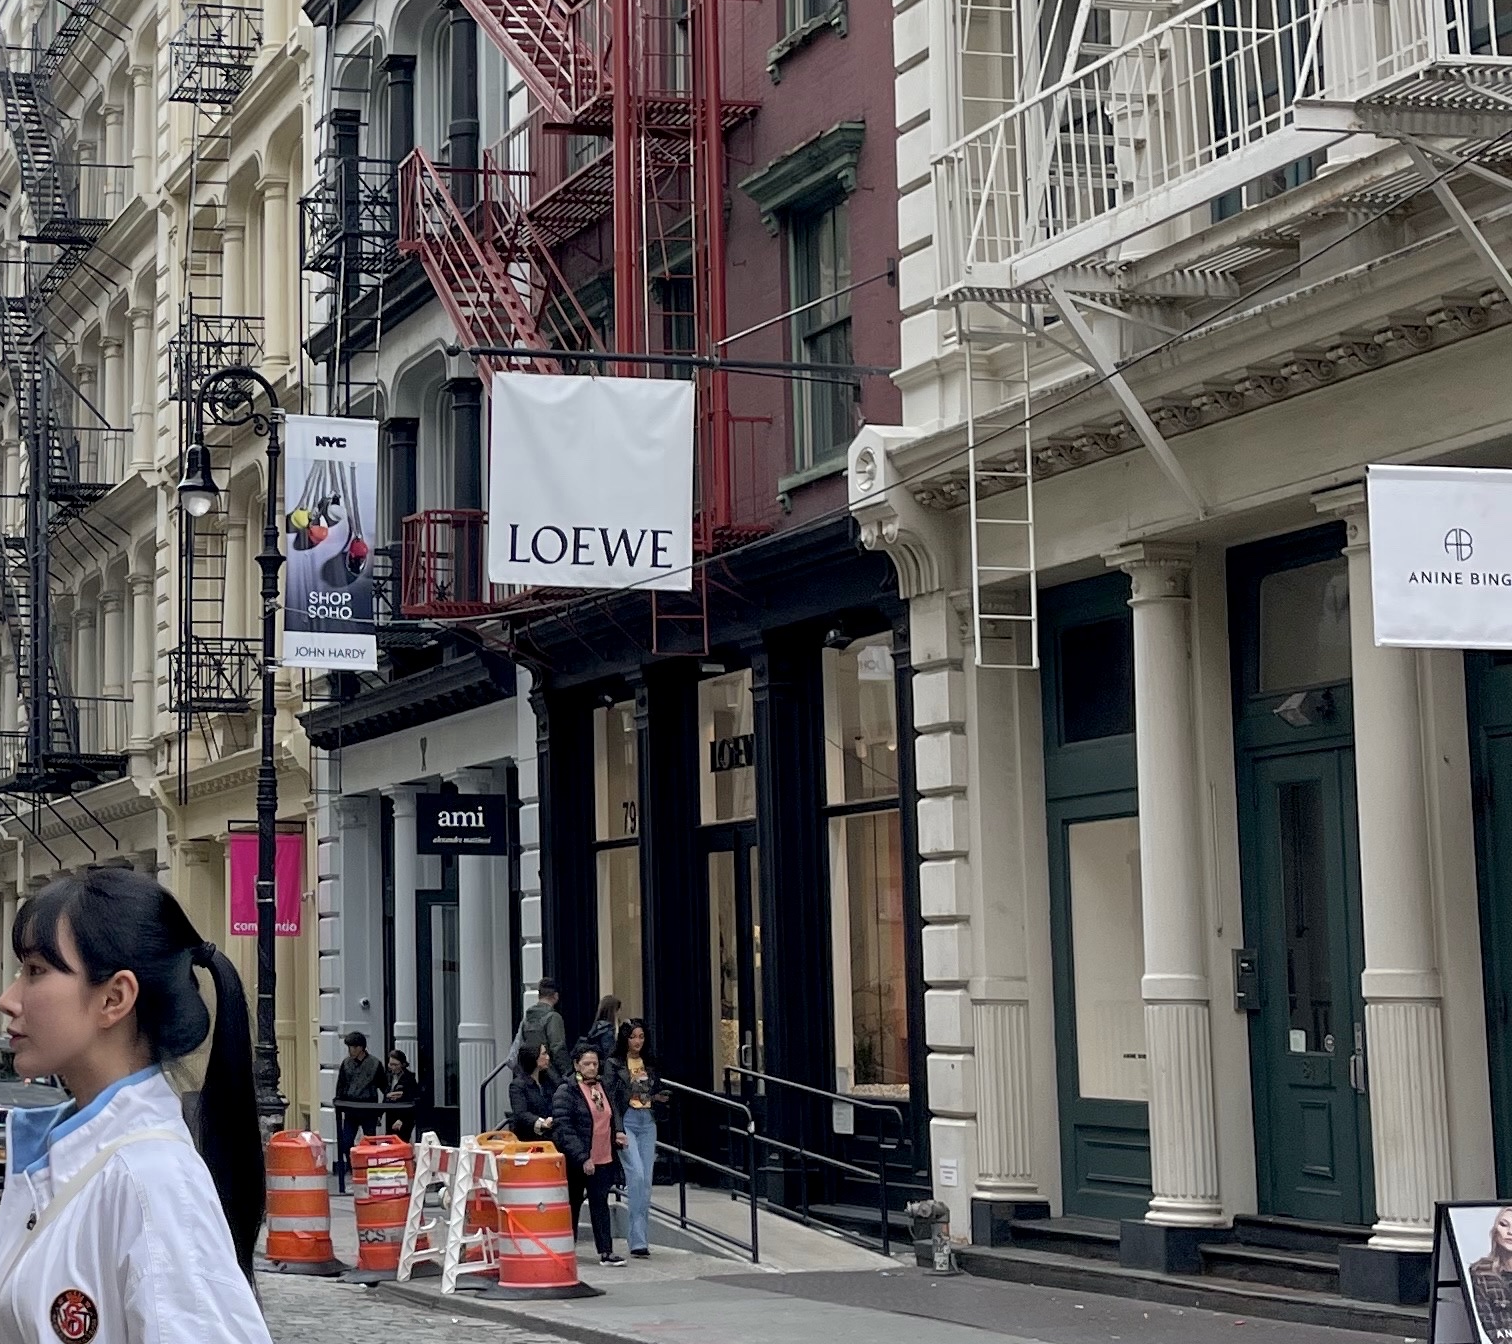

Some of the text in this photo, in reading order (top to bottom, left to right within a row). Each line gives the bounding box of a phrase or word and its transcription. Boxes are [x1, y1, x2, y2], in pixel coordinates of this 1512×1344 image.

[316, 436, 346, 448] NYC
[509, 524, 673, 568] LOEWE
[1409, 571, 1512, 586] ANINE BING
[309, 591, 351, 605] SHOP
[308, 605, 352, 619] SOHO
[294, 646, 366, 659] JOHN HARDY
[438, 806, 485, 827] ami
[622, 800, 637, 835] 79
[233, 919, 297, 932] comndo
